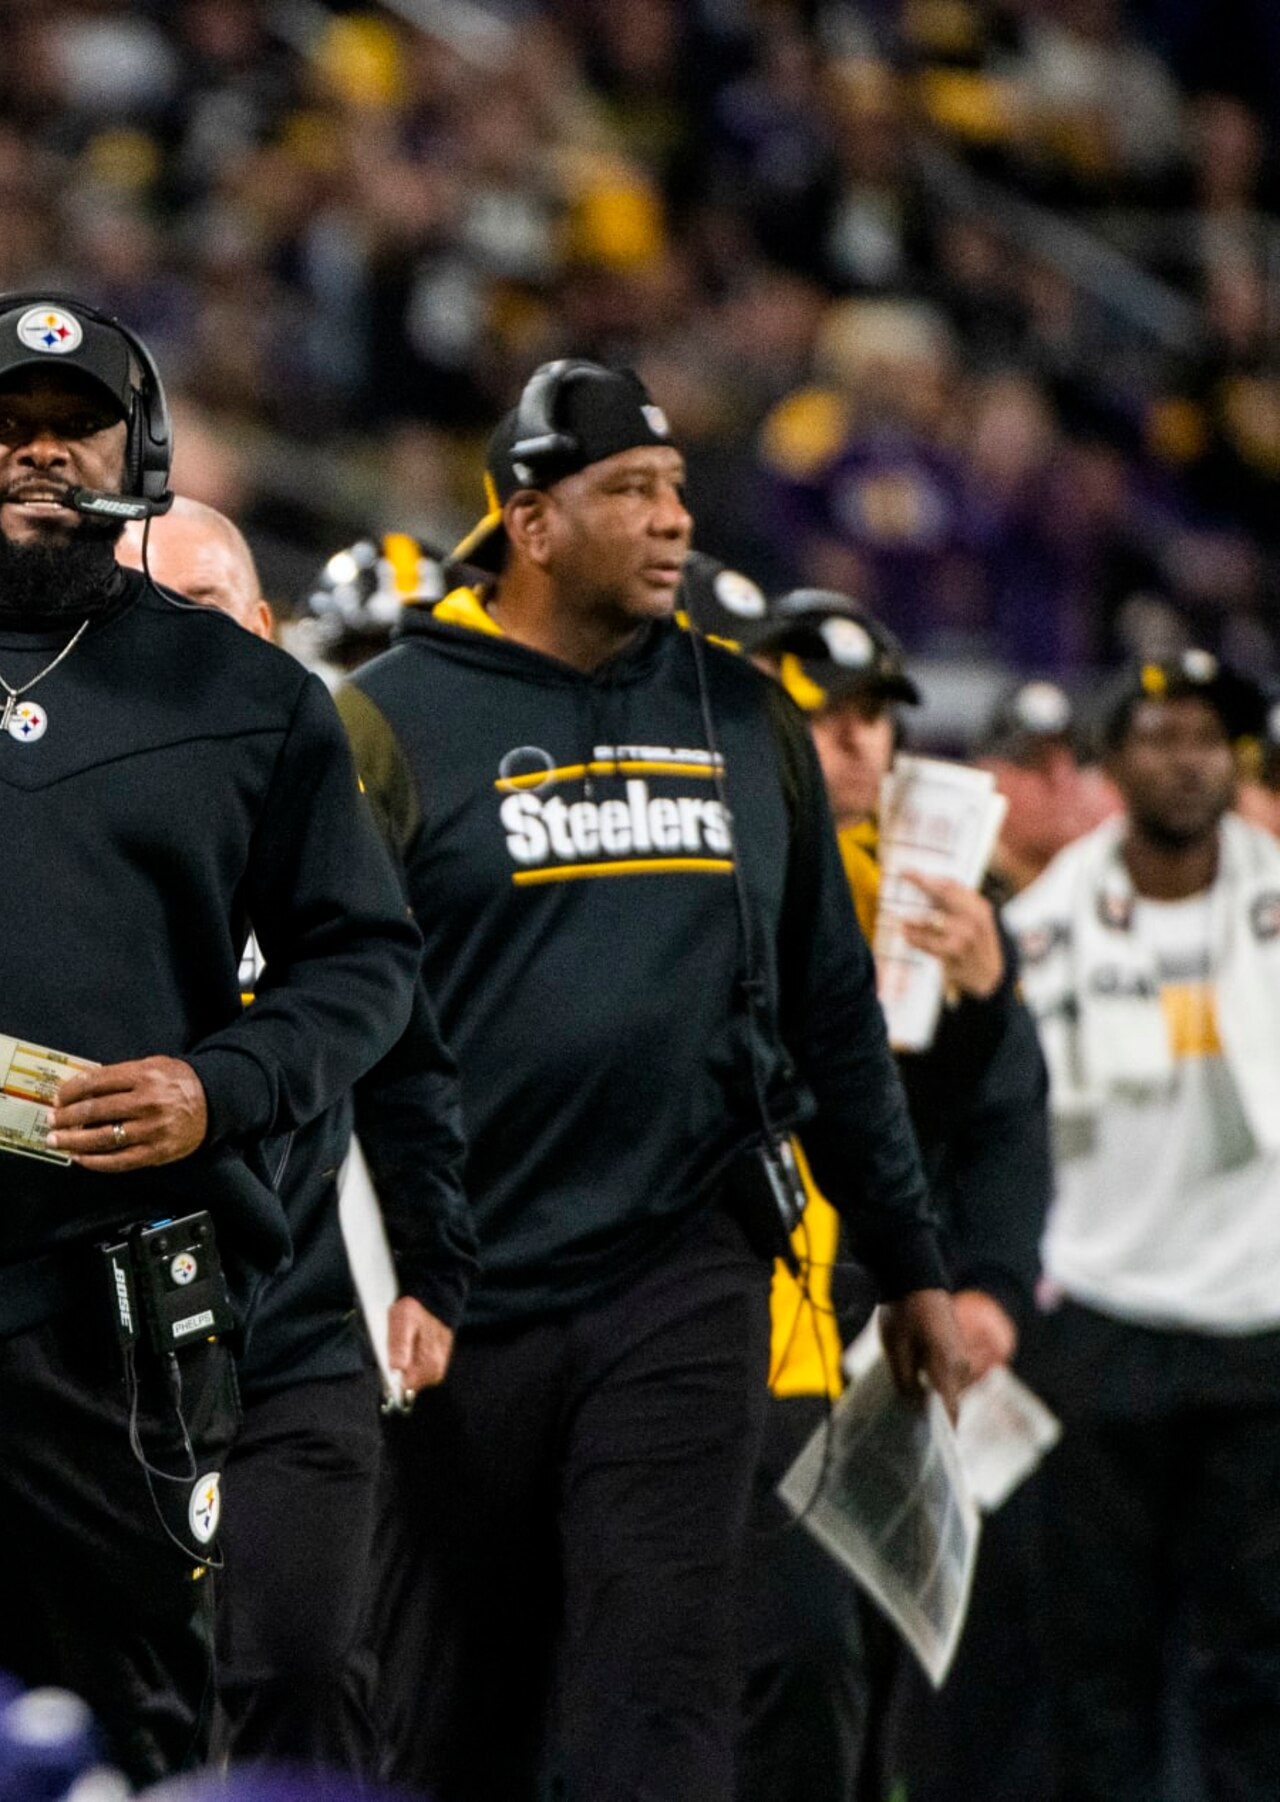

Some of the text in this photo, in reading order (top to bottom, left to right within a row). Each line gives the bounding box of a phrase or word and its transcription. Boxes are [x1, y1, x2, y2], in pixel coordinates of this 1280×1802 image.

[81, 498, 145, 516] BOSE
[500, 779, 733, 864] Steelers
[112, 1257, 134, 1334] BOSE
[174, 1313, 212, 1334] PHELPS
